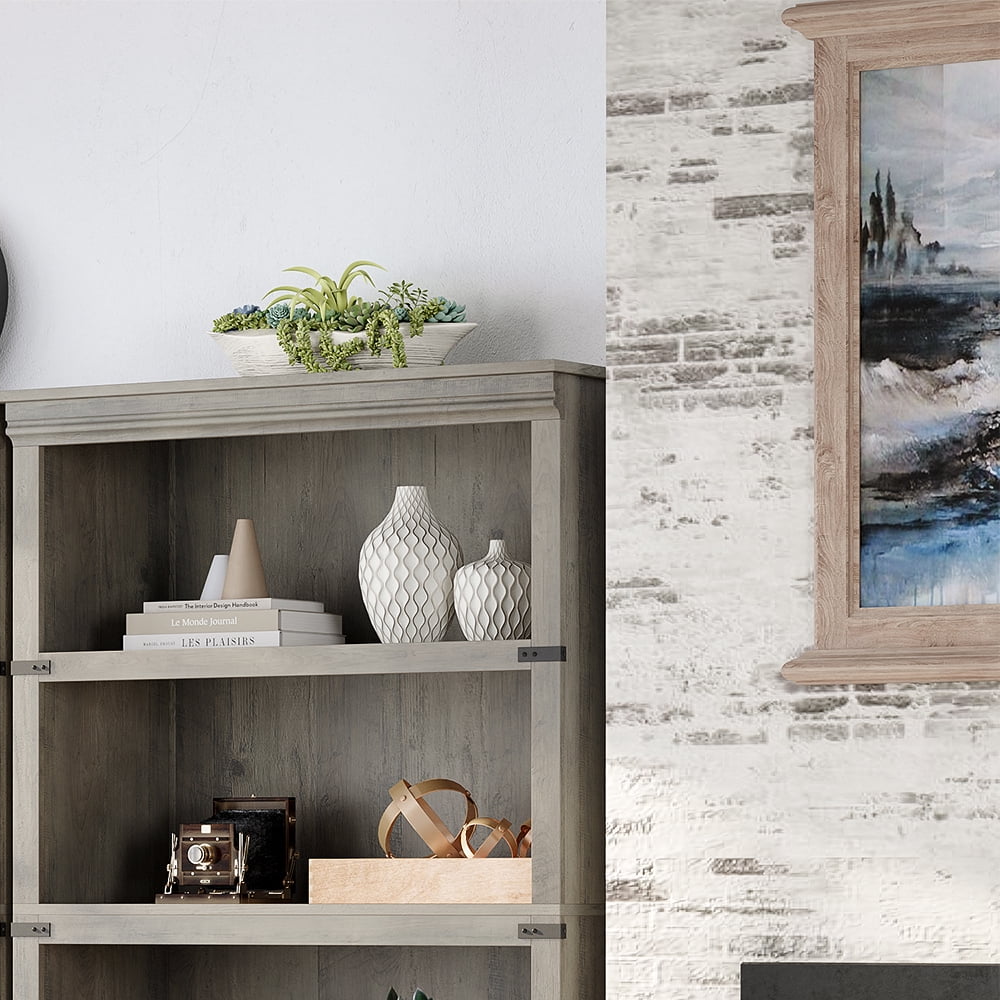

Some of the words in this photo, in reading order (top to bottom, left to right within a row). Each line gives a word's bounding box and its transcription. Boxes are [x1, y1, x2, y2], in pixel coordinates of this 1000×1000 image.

[213, 602, 232, 610] Design
[171, 618, 181, 626] Le
[182, 617, 208, 626] Monde
[209, 616, 238, 626] Journal
[182, 638, 200, 647] LES
[205, 637, 255, 647] PLAISIRS
